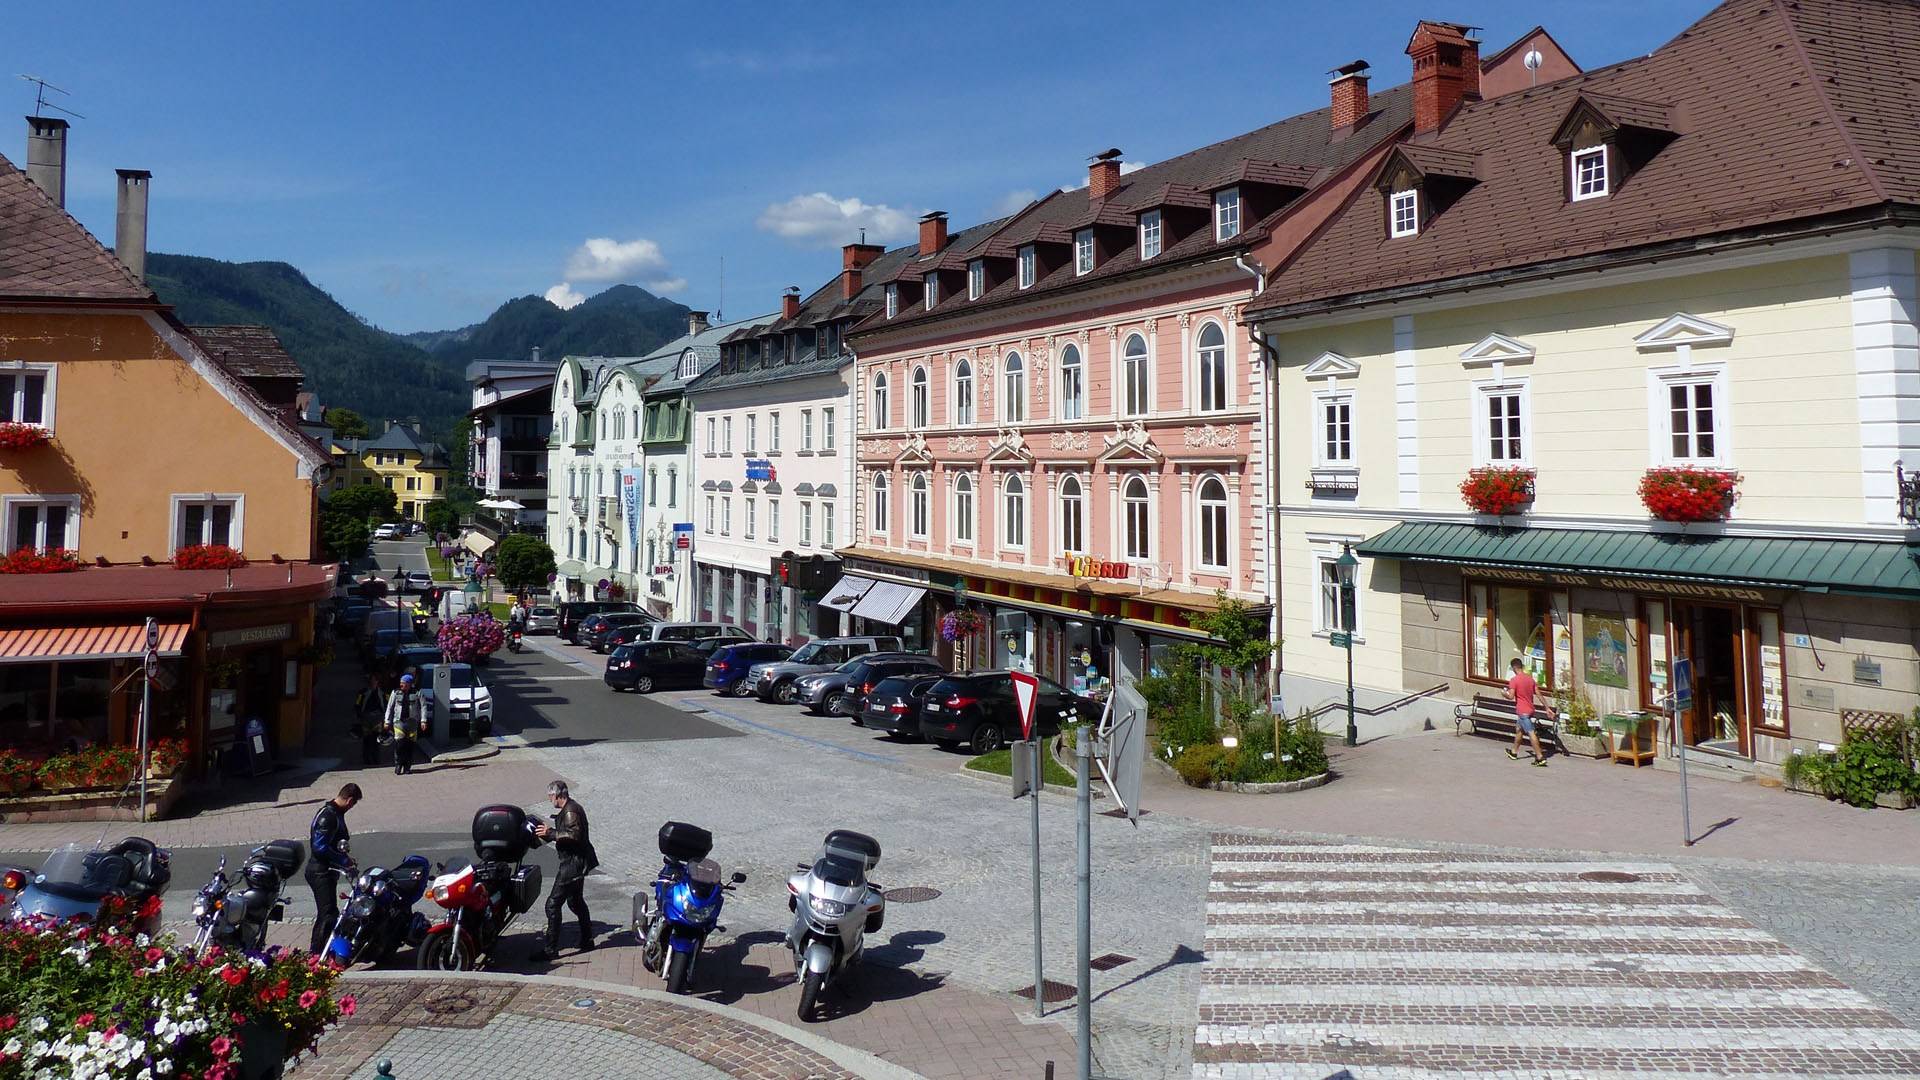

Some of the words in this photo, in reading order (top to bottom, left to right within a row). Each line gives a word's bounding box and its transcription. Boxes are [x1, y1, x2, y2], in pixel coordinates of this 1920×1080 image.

[655, 566, 674, 575] BIPA
[1460, 567, 1544, 582] APOTHEKE
[1551, 574, 1589, 585] ZUR
[1600, 578, 1765, 601] GNADENMUTTER
[241, 627, 286, 641] RESTAURANT
